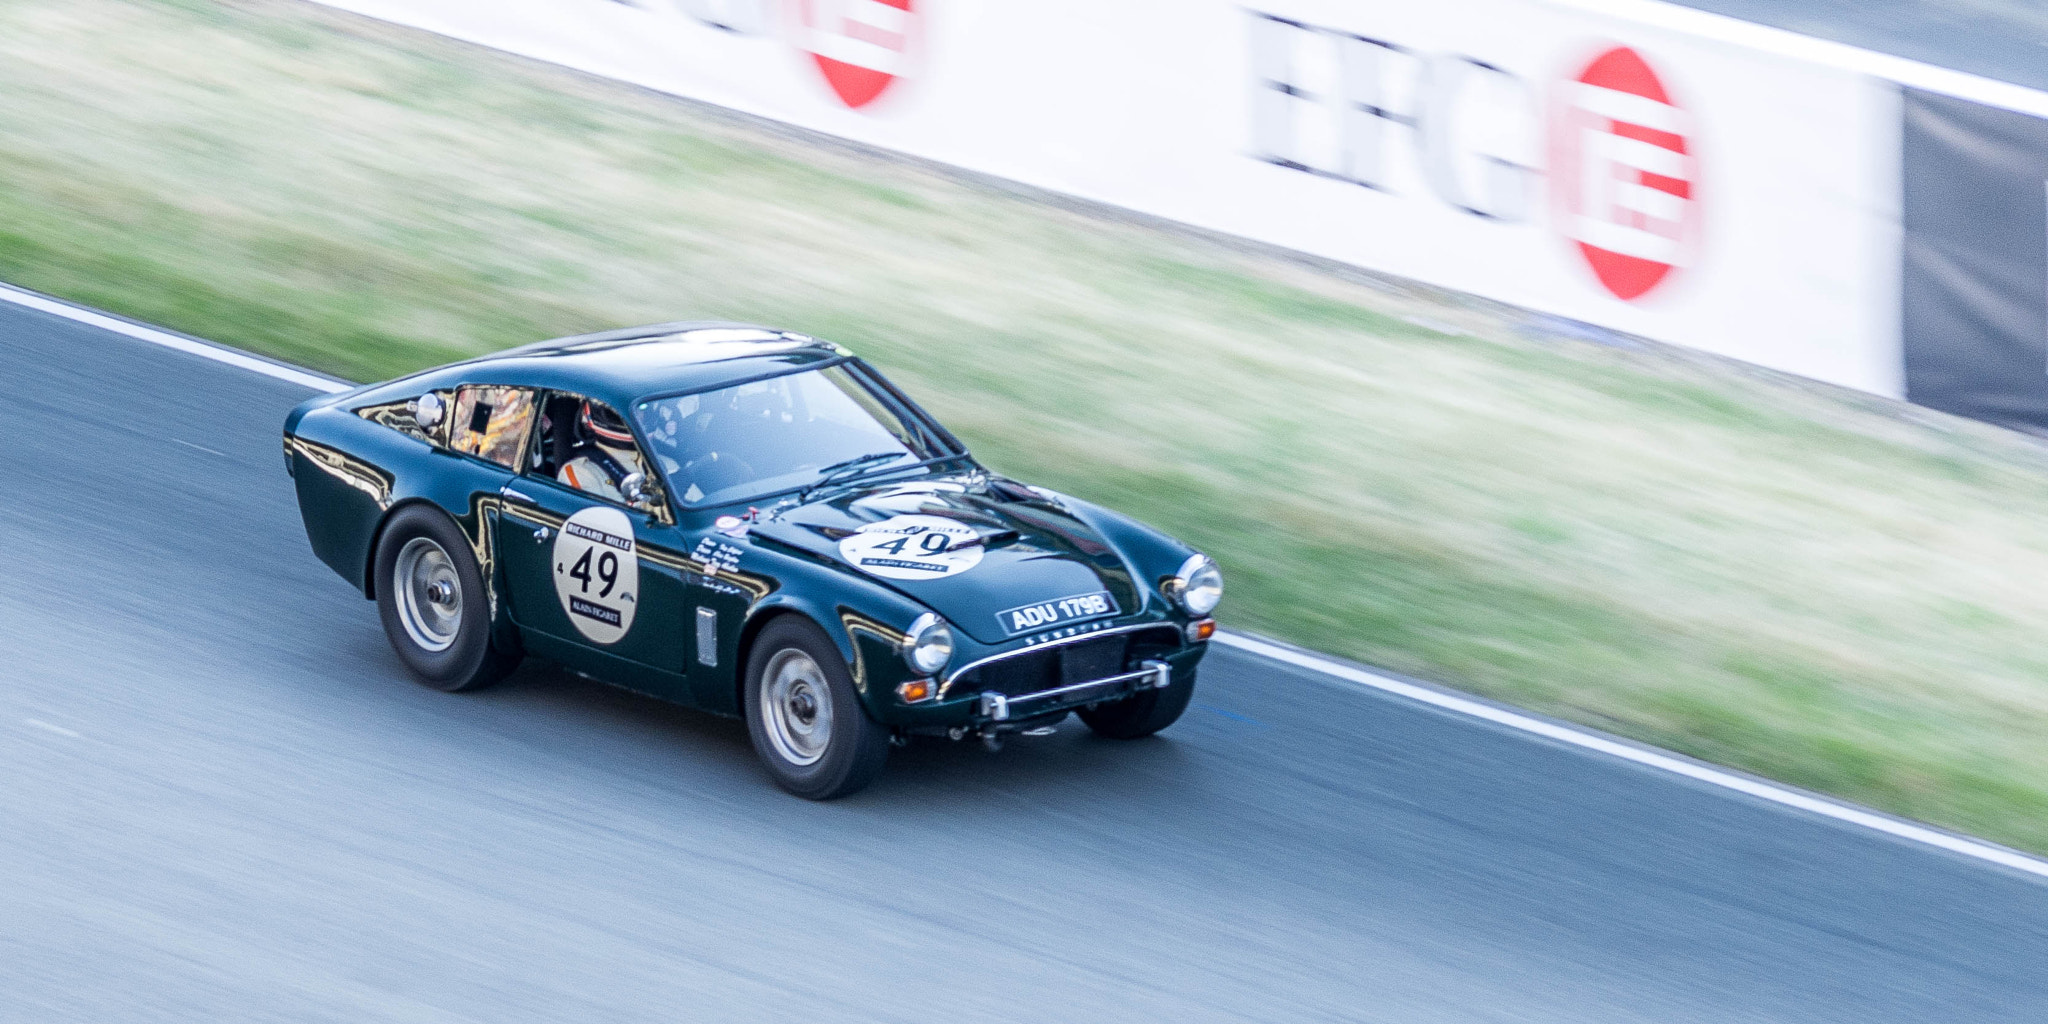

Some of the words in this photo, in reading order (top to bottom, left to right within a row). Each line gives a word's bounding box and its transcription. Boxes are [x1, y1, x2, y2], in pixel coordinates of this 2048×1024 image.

[1246, 8, 1542, 222] EFG
[567, 524, 603, 542] RICHARD
[606, 536, 631, 551] MILLE
[871, 532, 951, 557] 49
[571, 547, 618, 598] 49
[1012, 604, 1058, 630] ADU
[1059, 595, 1109, 618] 179B
